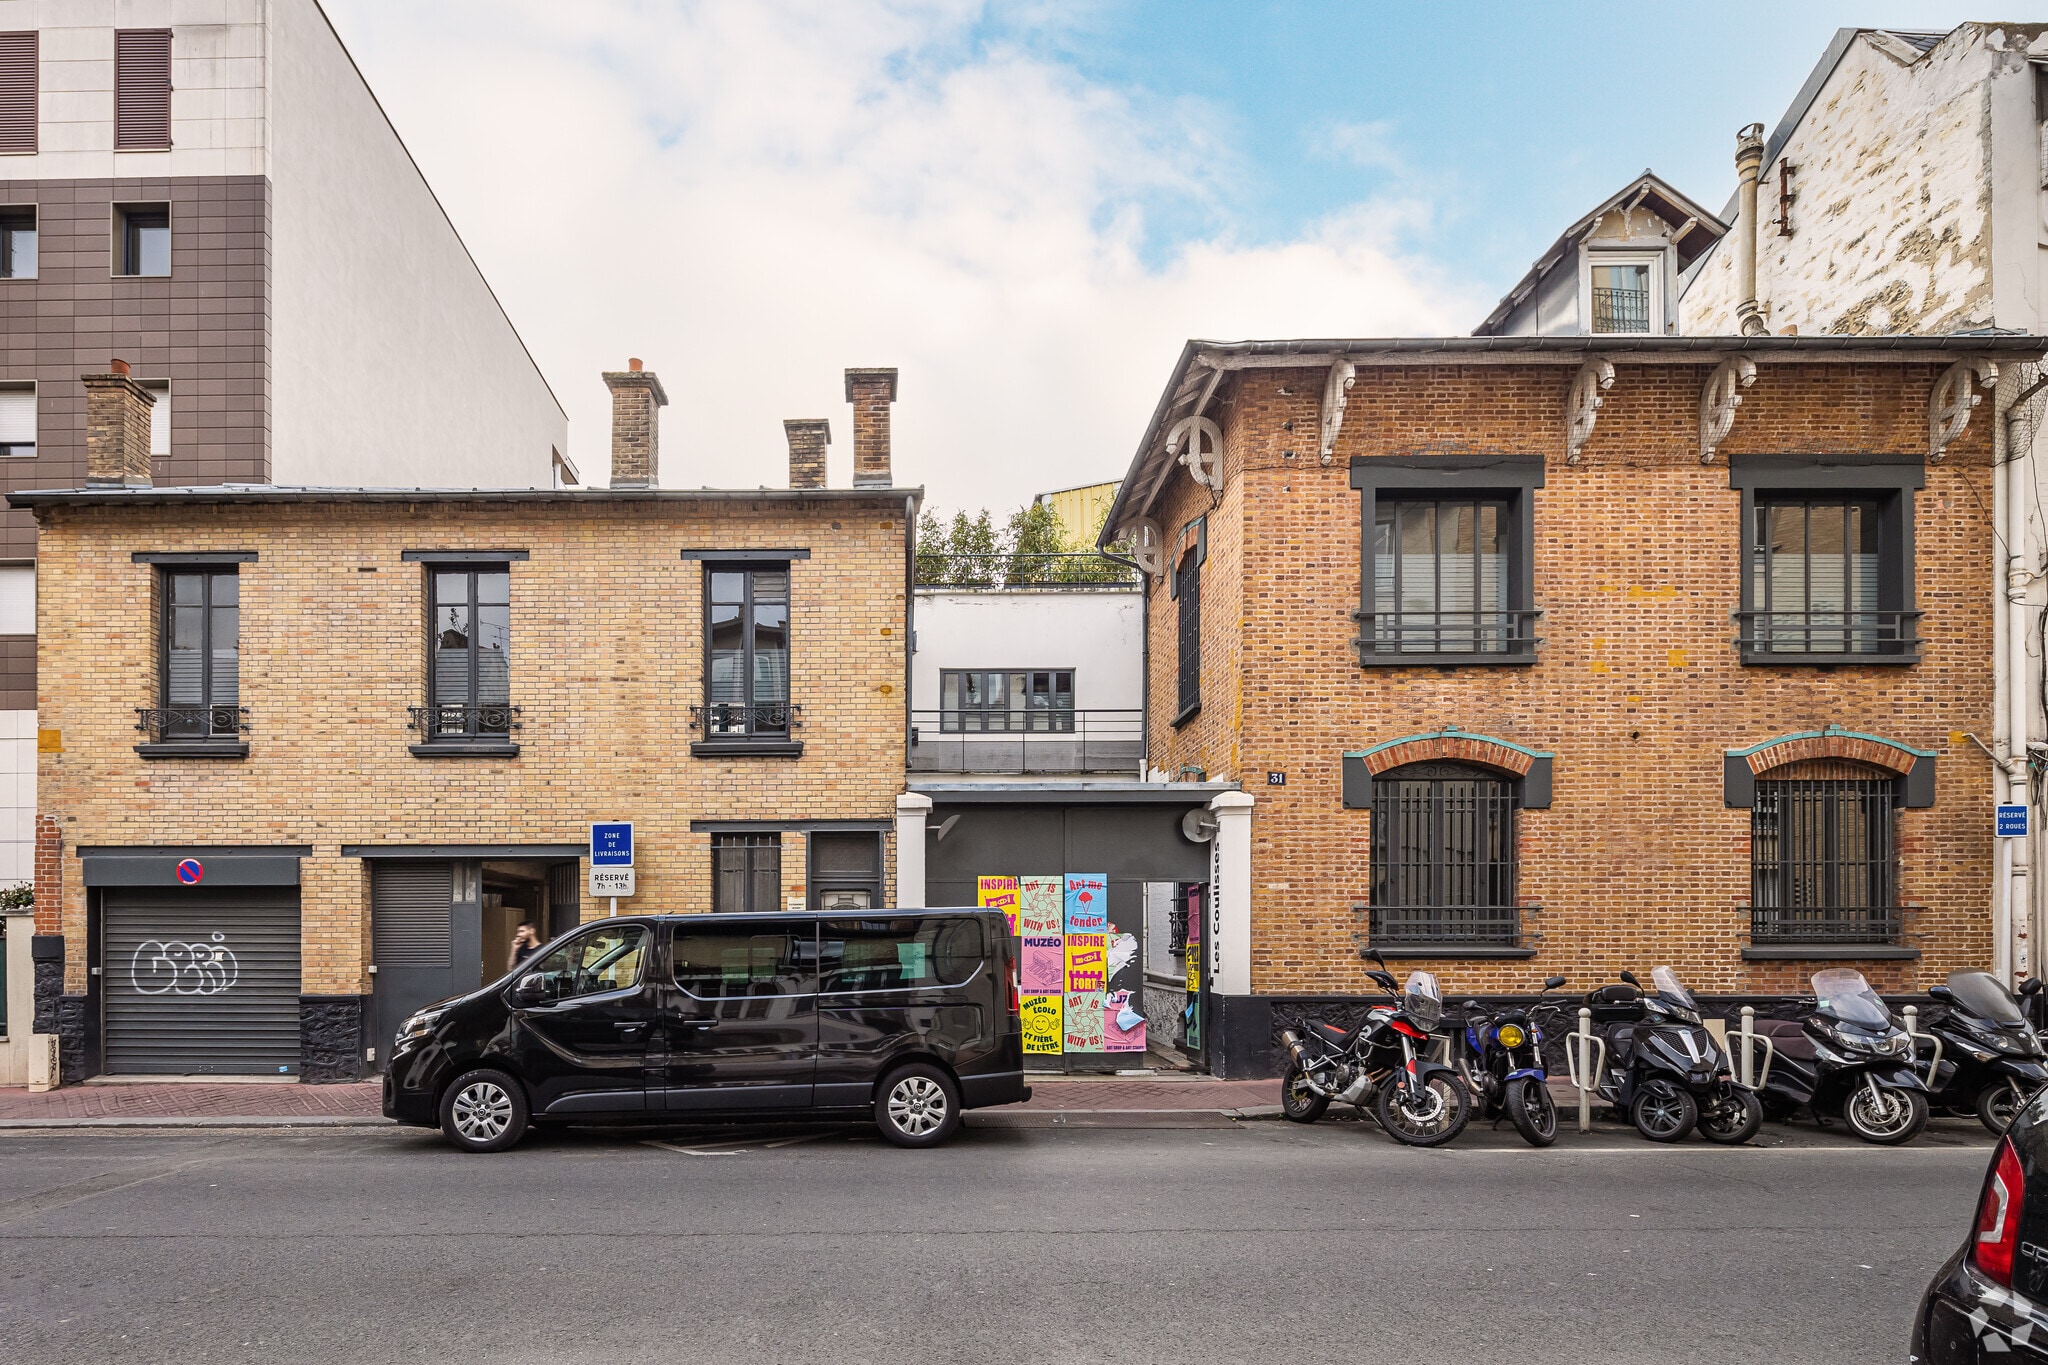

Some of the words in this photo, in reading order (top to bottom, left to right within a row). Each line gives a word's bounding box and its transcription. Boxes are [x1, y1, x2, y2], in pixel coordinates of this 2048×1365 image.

[1270, 773, 1283, 784] 31
[594, 873, 629, 881] RÉSERVÉ
[597, 882, 606, 890] 7h
[980, 878, 1018, 890] INSPIRE
[1025, 880, 1039, 892] ART
[1047, 883, 1056, 893] IS
[1069, 879, 1085, 891] Art
[1087, 880, 1102, 890] me
[1023, 918, 1043, 932] WITH
[1069, 915, 1103, 927] tender
[1024, 936, 1062, 947] MUZÉO
[1067, 935, 1105, 947] INSPIRE
[1074, 978, 1097, 989] FORT
[1023, 996, 1047, 1010] MUZÉO
[1069, 996, 1082, 1008] ART
[1090, 998, 1099, 1009] IS
[1033, 1006, 1056, 1015] ÉCOLO
[1024, 1032, 1033, 1040] ET
[1033, 1034, 1053, 1042] FIÈRE
[1067, 1033, 1087, 1048] WITH
[1036, 1041, 1059, 1051] L'ÊTRE
